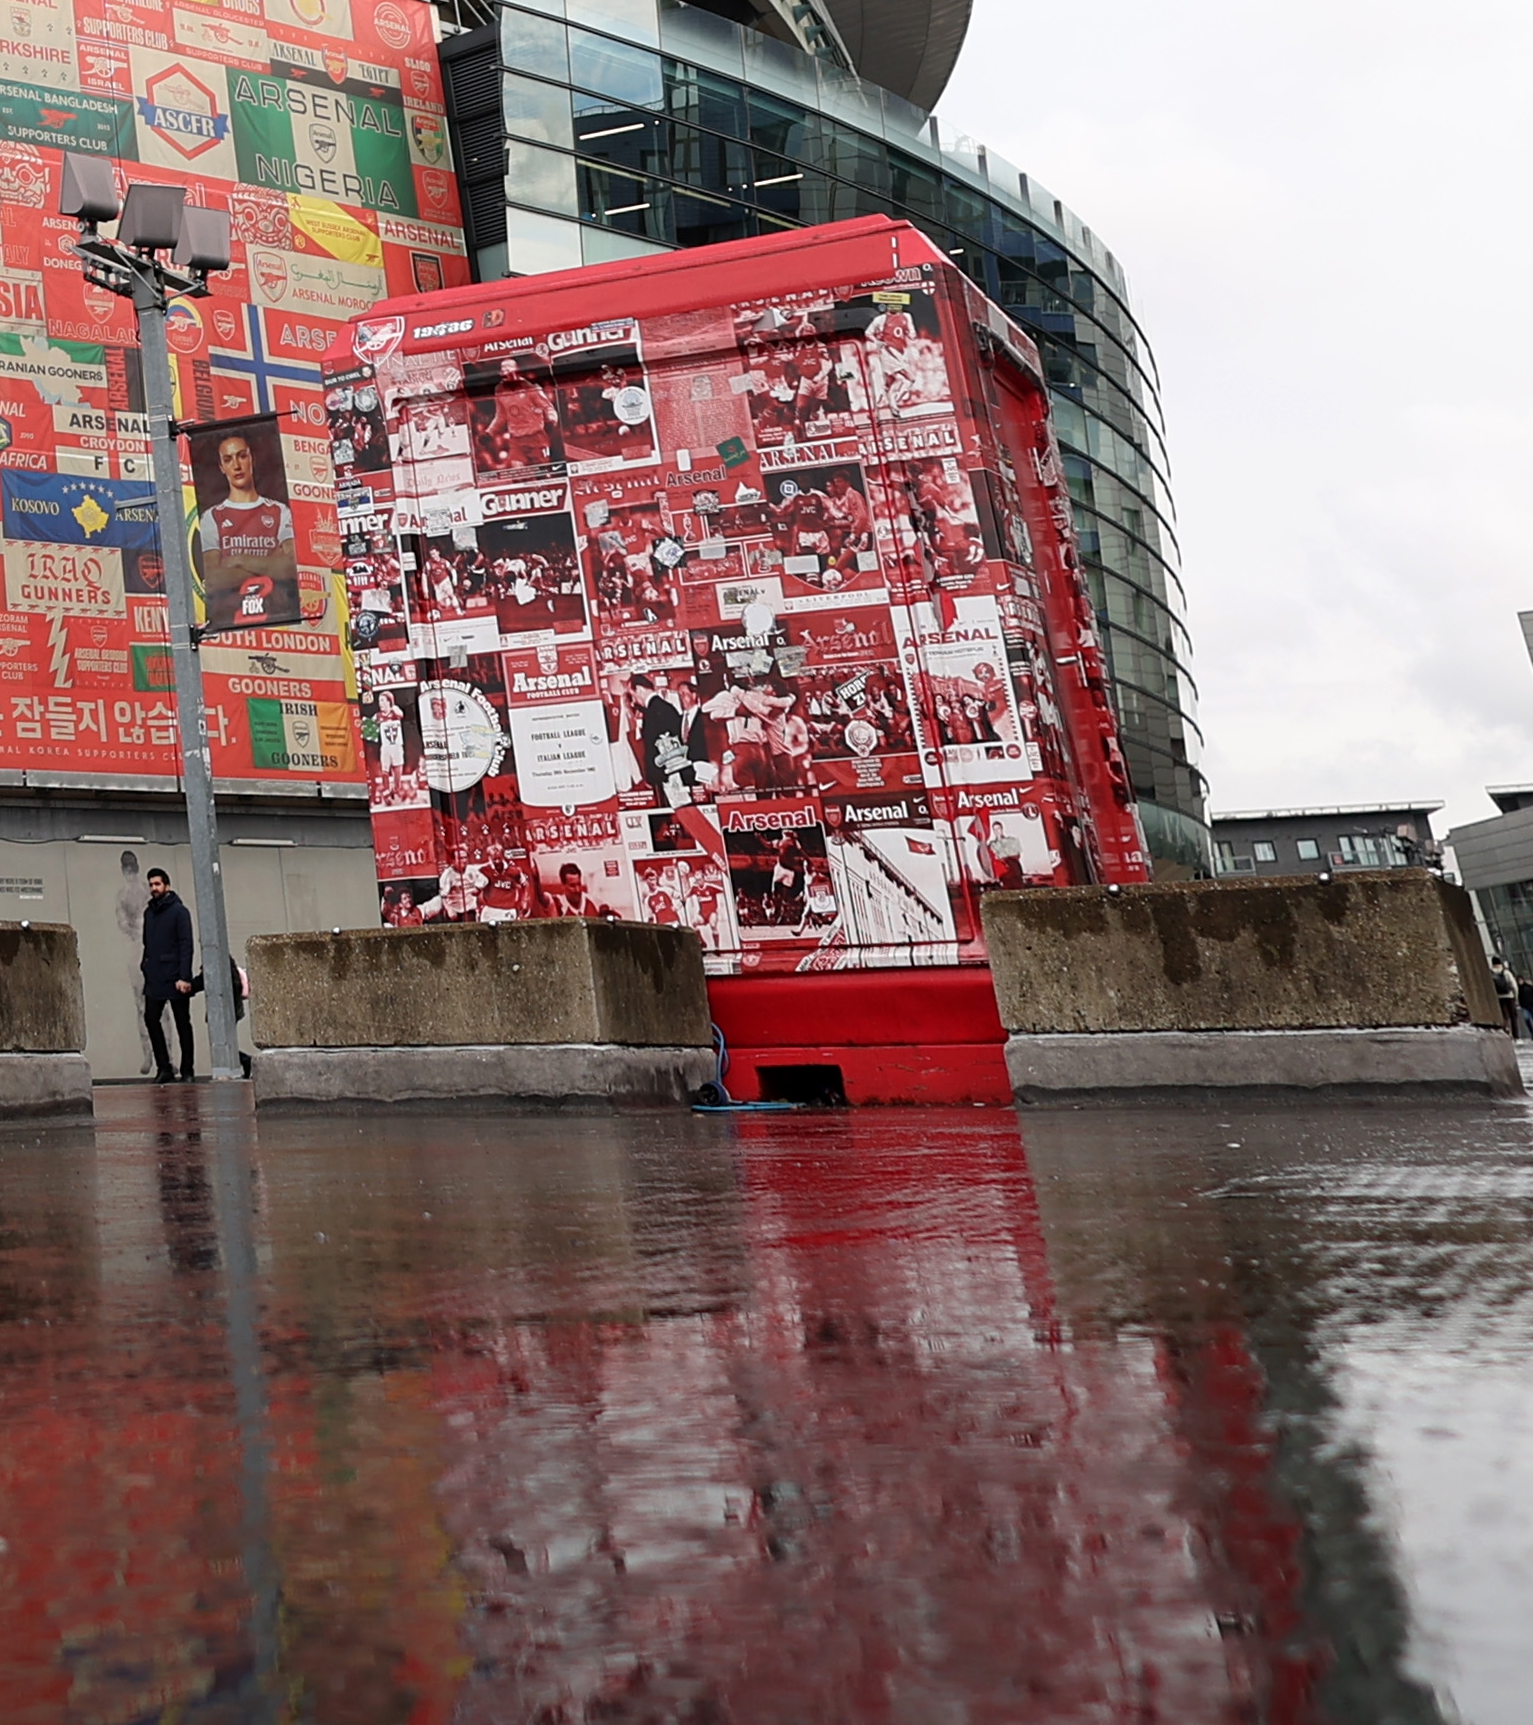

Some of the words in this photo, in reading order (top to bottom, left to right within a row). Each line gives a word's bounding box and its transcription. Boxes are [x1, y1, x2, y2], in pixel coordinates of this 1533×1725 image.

[44, 88, 118, 114] BANGLADESH
[153, 108, 214, 139] ASCFR
[7, 124, 76, 148] SUPPORTERS
[80, 133, 108, 151] CLUB
[255, 152, 399, 209] NIGERIA
[665, 464, 727, 487] Arsenal
[11, 497, 60, 516] KOSOVO
[482, 489, 563, 515] Gunner
[222, 535, 275, 549] Emirates
[242, 598, 264, 615] FOX
[711, 632, 770, 653] Arsenal
[513, 666, 592, 693] Arsenal
[14, 695, 107, 743] 잠들지
[279, 703, 318, 716] IRISH
[531, 732, 561, 741] FOOTBALL
[563, 729, 586, 738] LEAGUE
[537, 753, 561, 762] ITALIAN
[563, 751, 586, 760] LEAGUE
[958, 788, 1021, 808] Arsenal
[728, 806, 816, 831] Arsenal
[844, 801, 908, 822] Arsenal
